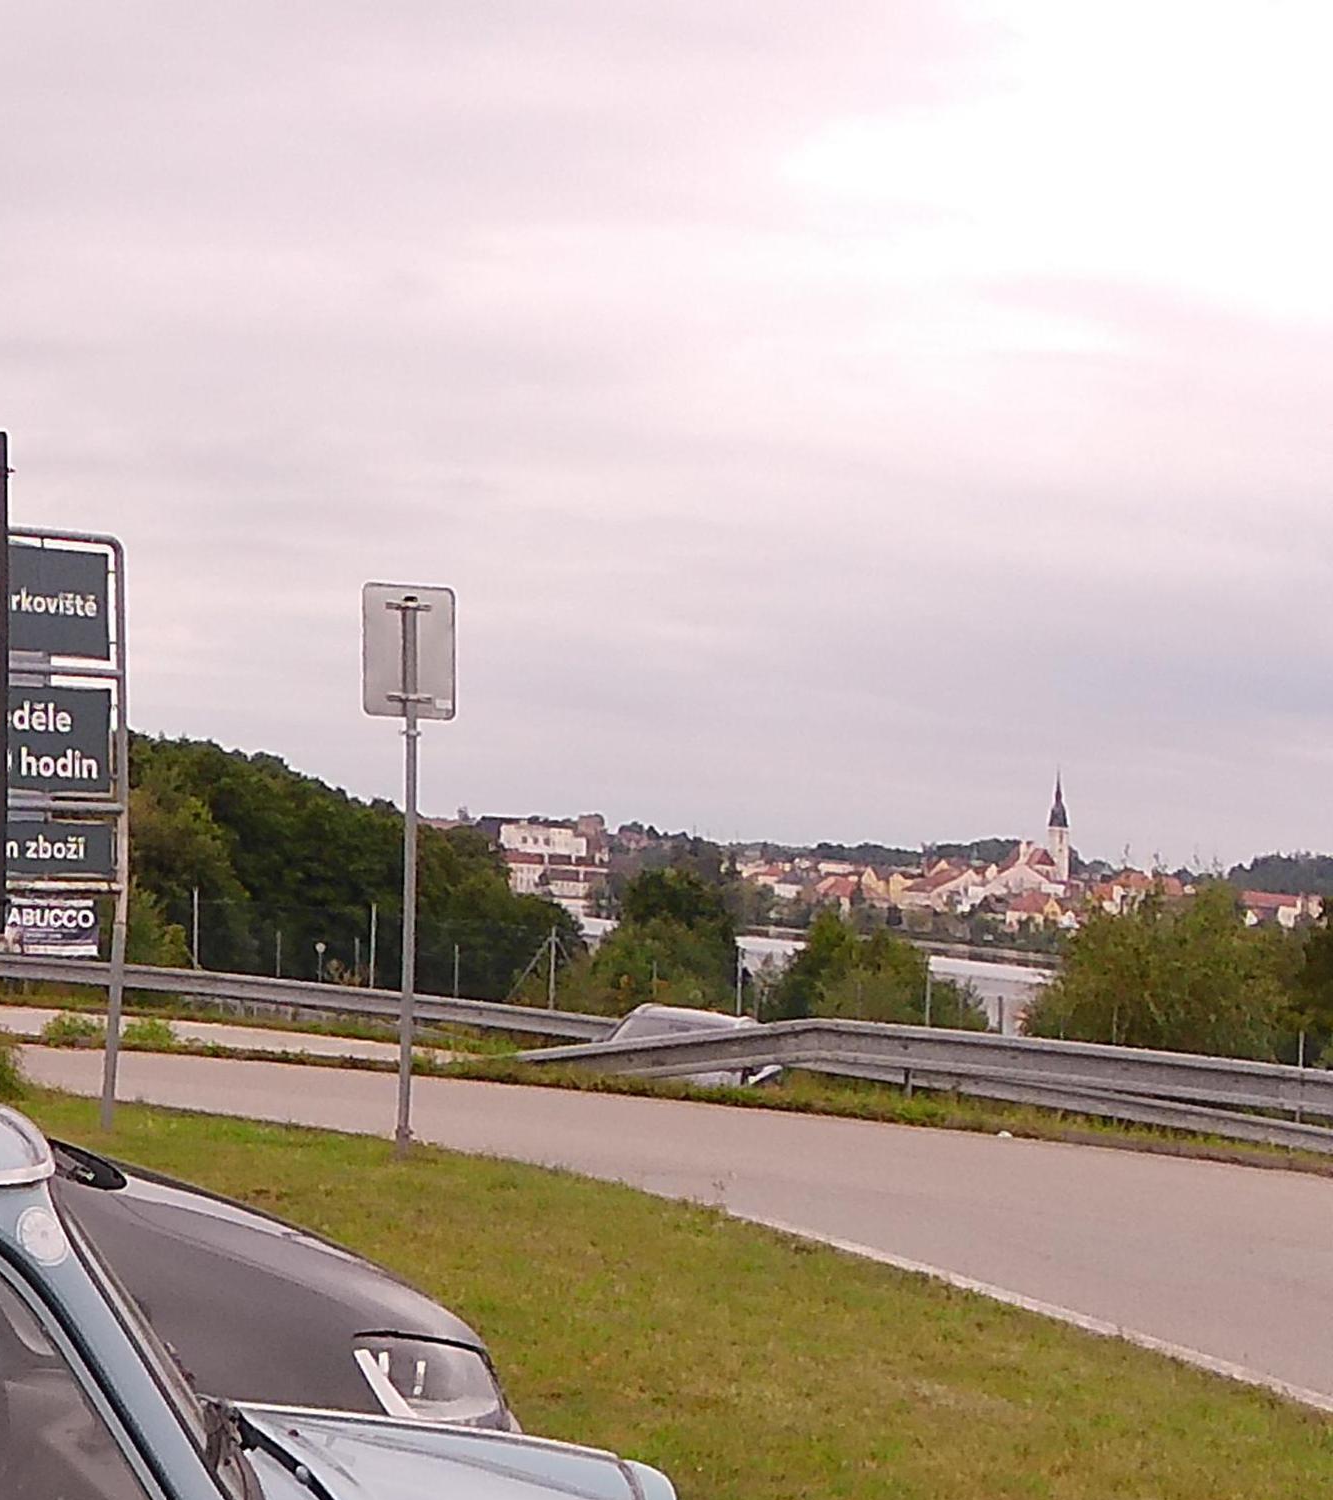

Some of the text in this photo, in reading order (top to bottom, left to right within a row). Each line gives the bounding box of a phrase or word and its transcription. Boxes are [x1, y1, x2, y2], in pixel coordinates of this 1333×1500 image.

[20, 746, 98, 779] hodin
[25, 834, 85, 859] zboží
[6, 907, 95, 928] ABUCCO
